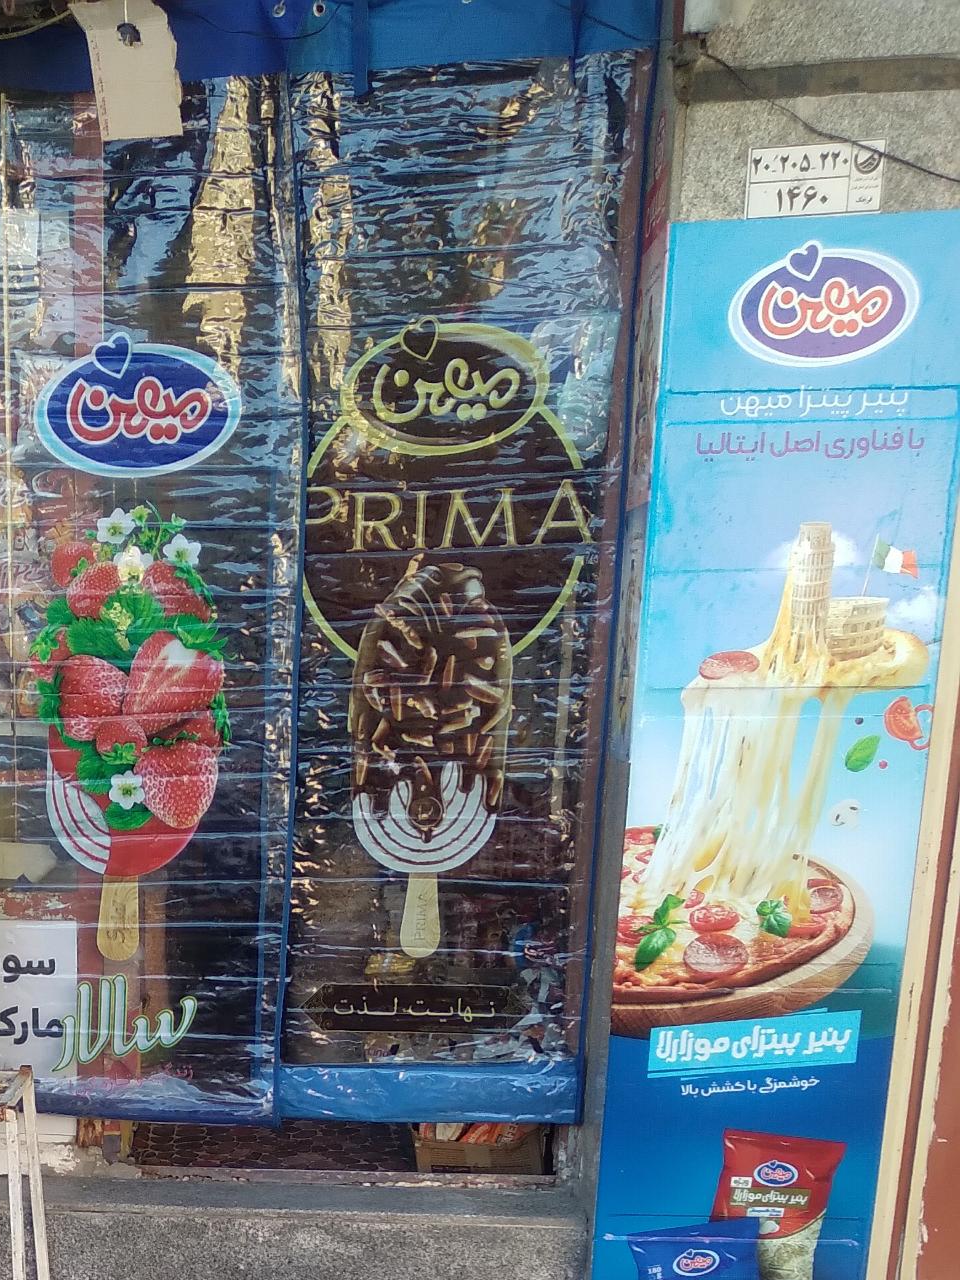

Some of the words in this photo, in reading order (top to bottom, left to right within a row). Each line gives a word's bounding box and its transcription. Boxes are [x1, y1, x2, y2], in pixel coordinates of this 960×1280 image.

[776, 185, 829, 213] ۱۴۶۰
[759, 278, 891, 338] میهن
[372, 357, 521, 424] میهن
[720, 392, 792, 418] میهن
[798, 384, 852, 418] پیتزا
[855, 387, 909, 416] پنیر
[68, 377, 211, 443] میهن
[695, 432, 766, 462] ایتالیا
[769, 431, 821, 458] اصل
[823, 426, 905, 459] فناوری
[908, 427, 925, 457] با
[305, 479, 596, 552] PRIMA
[333, 995, 399, 1016] لذت
[407, 997, 496, 1023] نهایت
[51, 972, 198, 1072] سالار
[655, 1029, 731, 1063] موزارلا
[731, 1025, 802, 1059] پیتزای
[803, 1026, 853, 1054] پنیر
[680, 1083, 700, 1099] بالا
[700, 1080, 746, 1098] کشش
[746, 1079, 758, 1096] با
